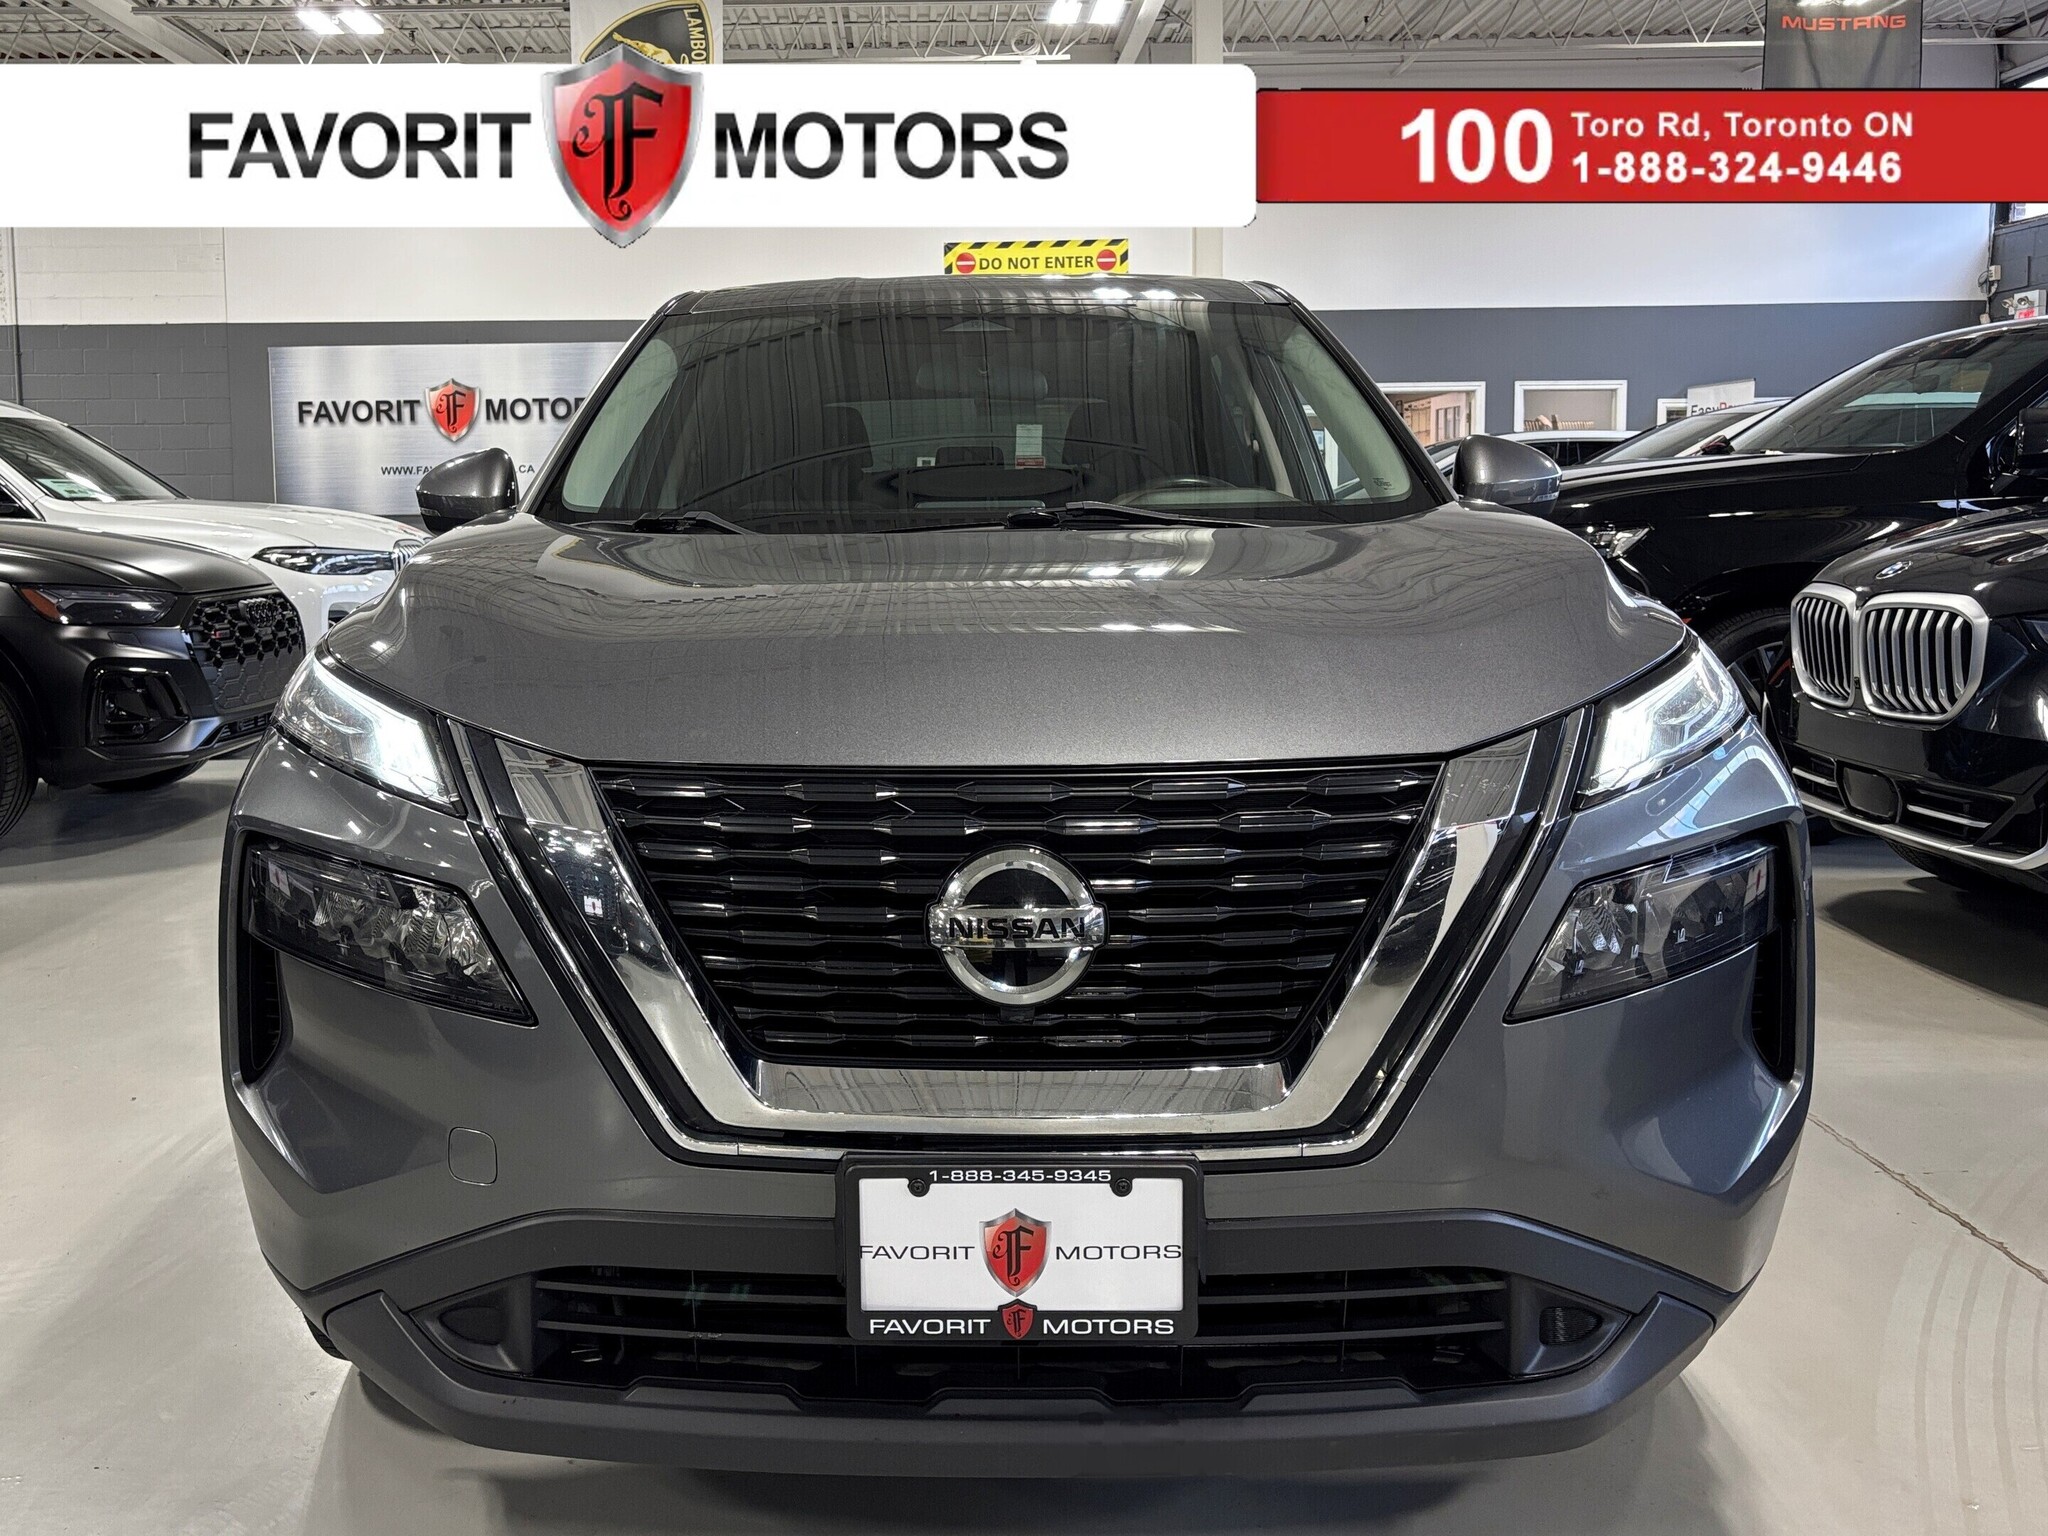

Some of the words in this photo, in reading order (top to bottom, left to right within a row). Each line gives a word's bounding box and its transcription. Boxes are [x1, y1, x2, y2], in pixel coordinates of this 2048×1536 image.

[1781, 15, 1907, 31] MUSTANG
[682, 8, 707, 64] LAMBO
[979, 257, 1003, 270] DO
[1007, 257, 1040, 270] NOT
[1045, 255, 1094, 269] ENTER
[298, 400, 421, 423] FAVORIT
[381, 465, 433, 475] WWW.FA
[949, 917, 1085, 939] NISSAN
[929, 1169, 1112, 1182] 1-888-345-9345
[860, 1245, 975, 1260] FAVORIT
[1056, 1245, 1182, 1260] MOTORS
[869, 1319, 991, 1335] FAVORIT
[1043, 1319, 1175, 1335] MOTORS
